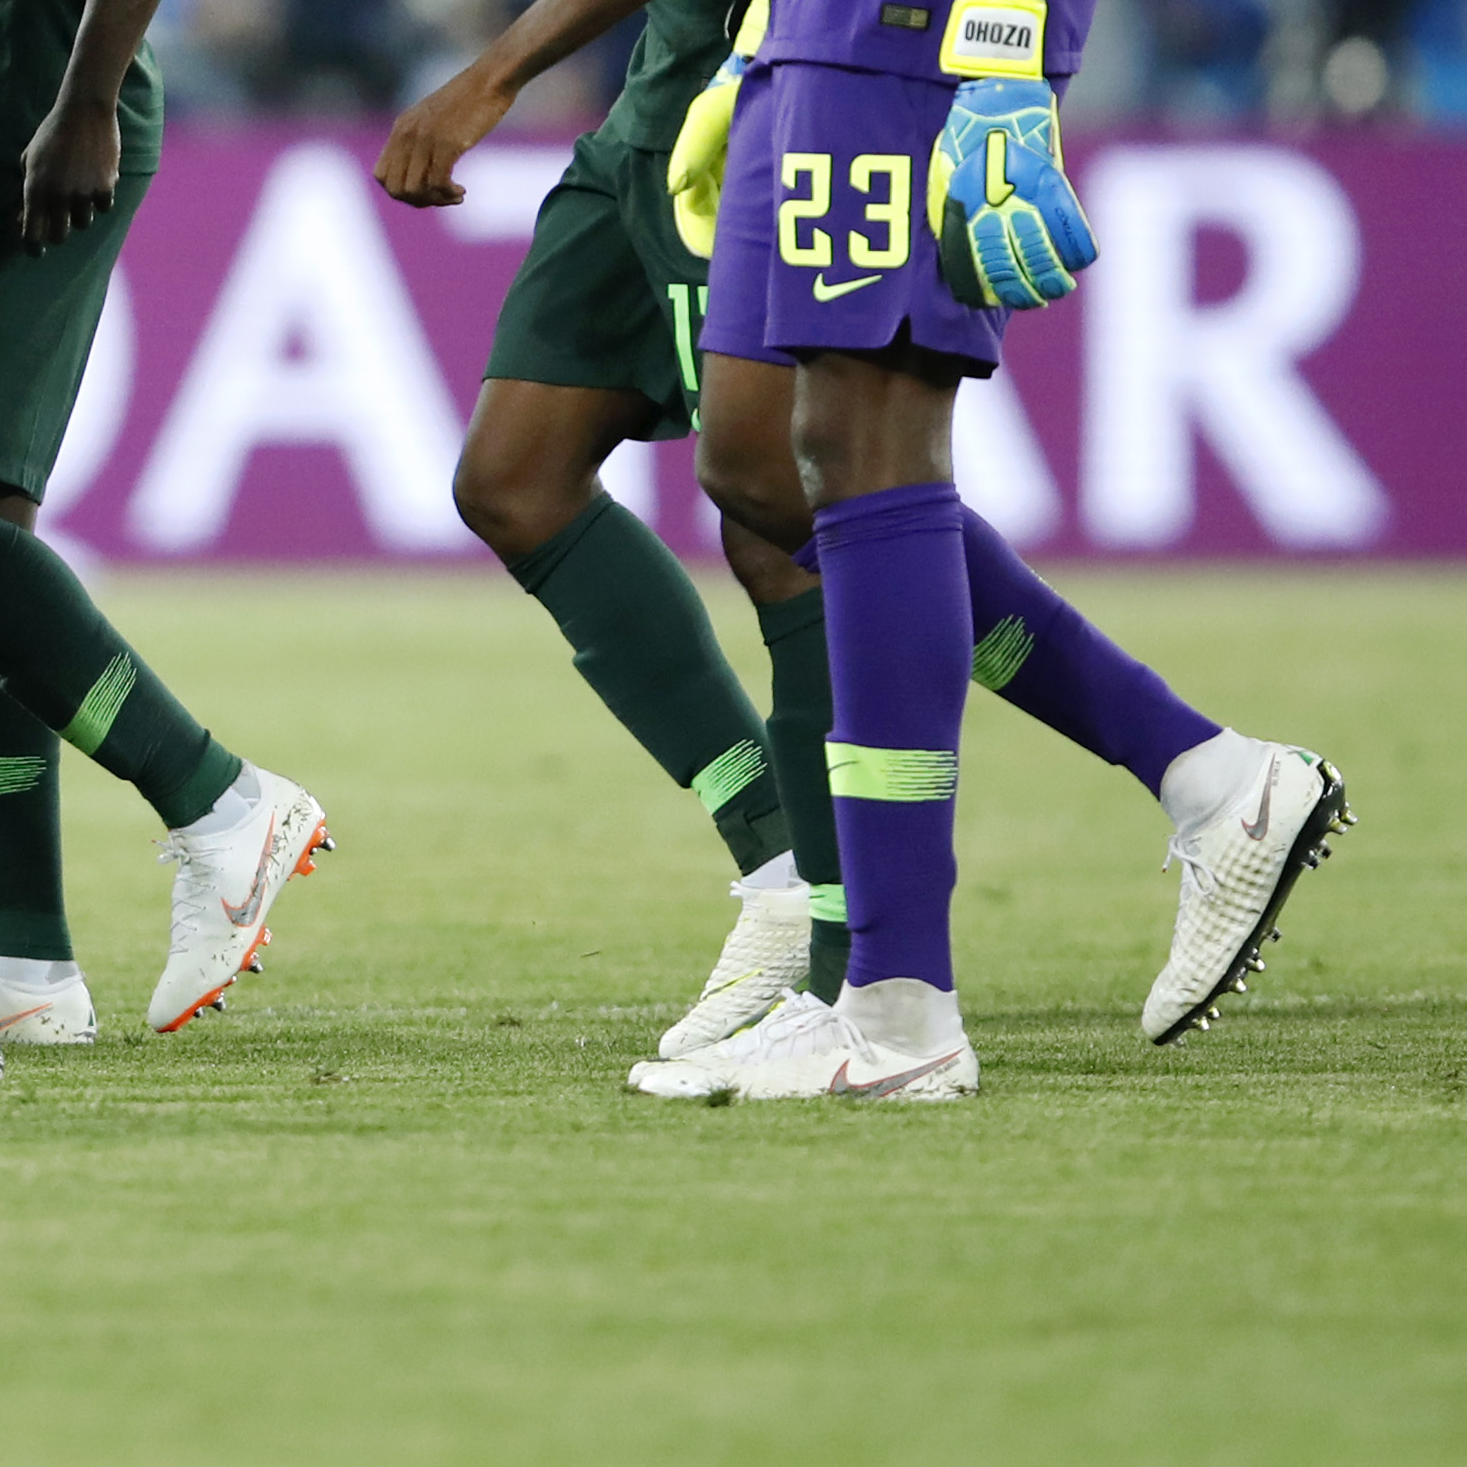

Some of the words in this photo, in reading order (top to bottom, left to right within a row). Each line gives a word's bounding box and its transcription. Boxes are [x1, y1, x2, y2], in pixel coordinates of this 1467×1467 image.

[964, 20, 1032, 49] UZOHO
[778, 152, 912, 269] 23
[667, 283, 710, 392] 1
